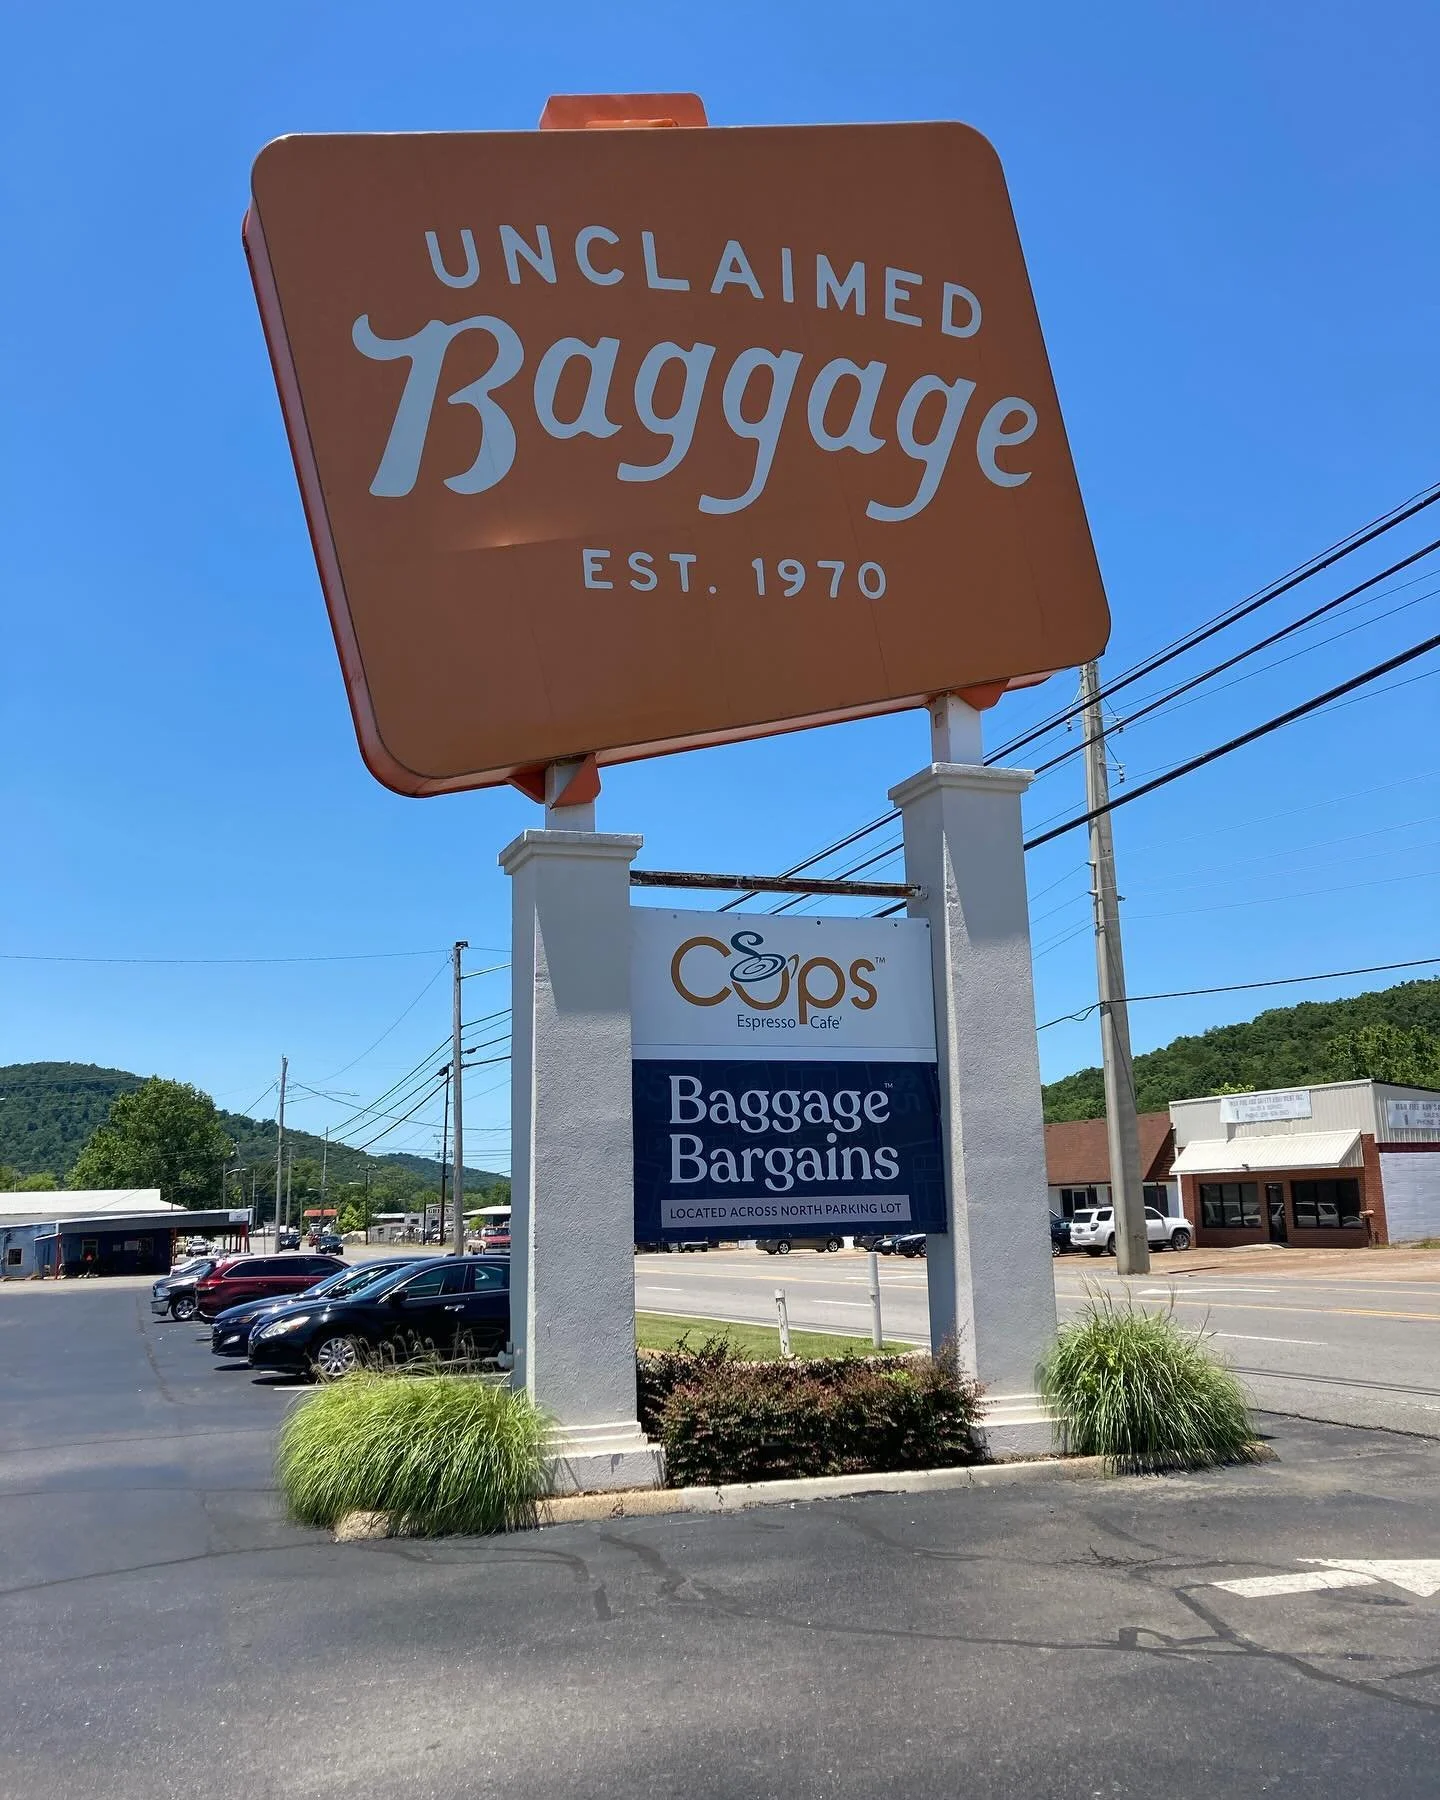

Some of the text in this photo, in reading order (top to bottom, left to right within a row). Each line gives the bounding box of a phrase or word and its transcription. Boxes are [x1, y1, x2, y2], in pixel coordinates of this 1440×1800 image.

[424, 224, 983, 339] UNCLAIMED
[351, 313, 1039, 522] Baggage
[582, 548, 888, 601] EST. 1970
[736, 1013, 797, 1031] Espresso
[669, 1132, 900, 1192] Bargains
[669, 1202, 902, 1220] LOCATED ACROSS NORTH PARKING LOT
